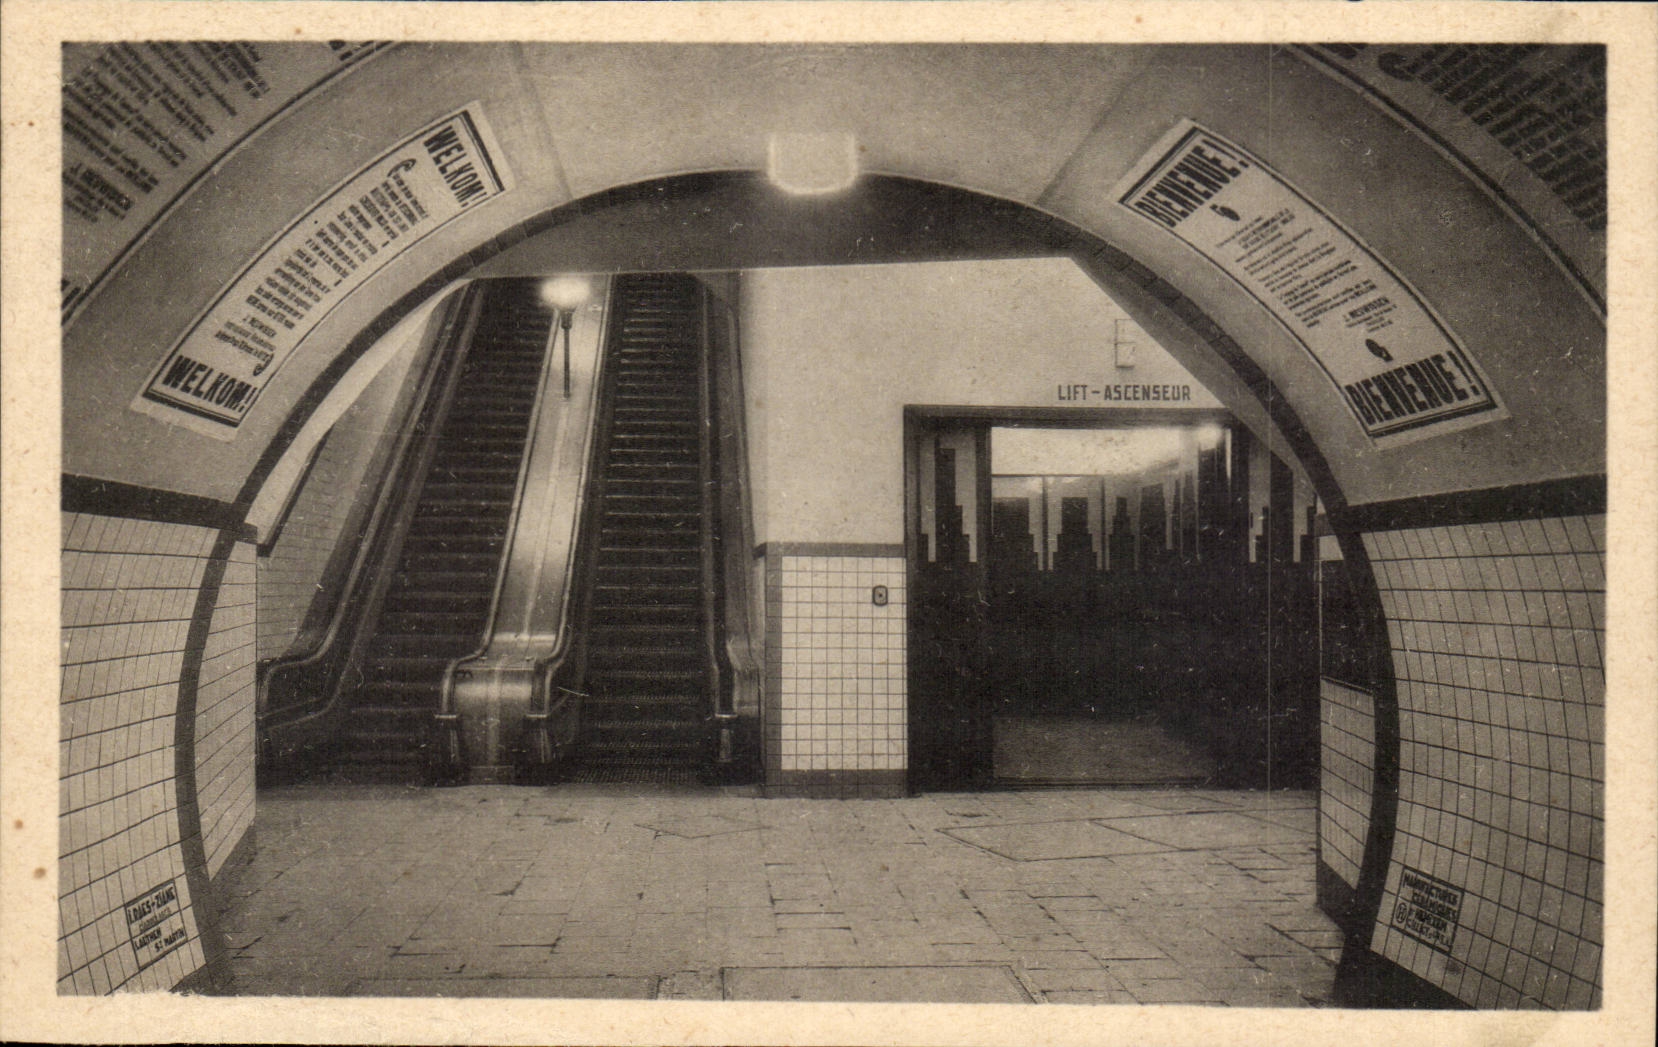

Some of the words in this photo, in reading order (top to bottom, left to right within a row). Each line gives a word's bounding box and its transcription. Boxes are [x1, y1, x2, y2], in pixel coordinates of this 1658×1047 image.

[423, 124, 488, 208] WELKOM!
[1133, 138, 1249, 229] BIENVENUE!
[162, 354, 258, 413] WELKOM!
[1344, 349, 1481, 426] BIENVENUE!
